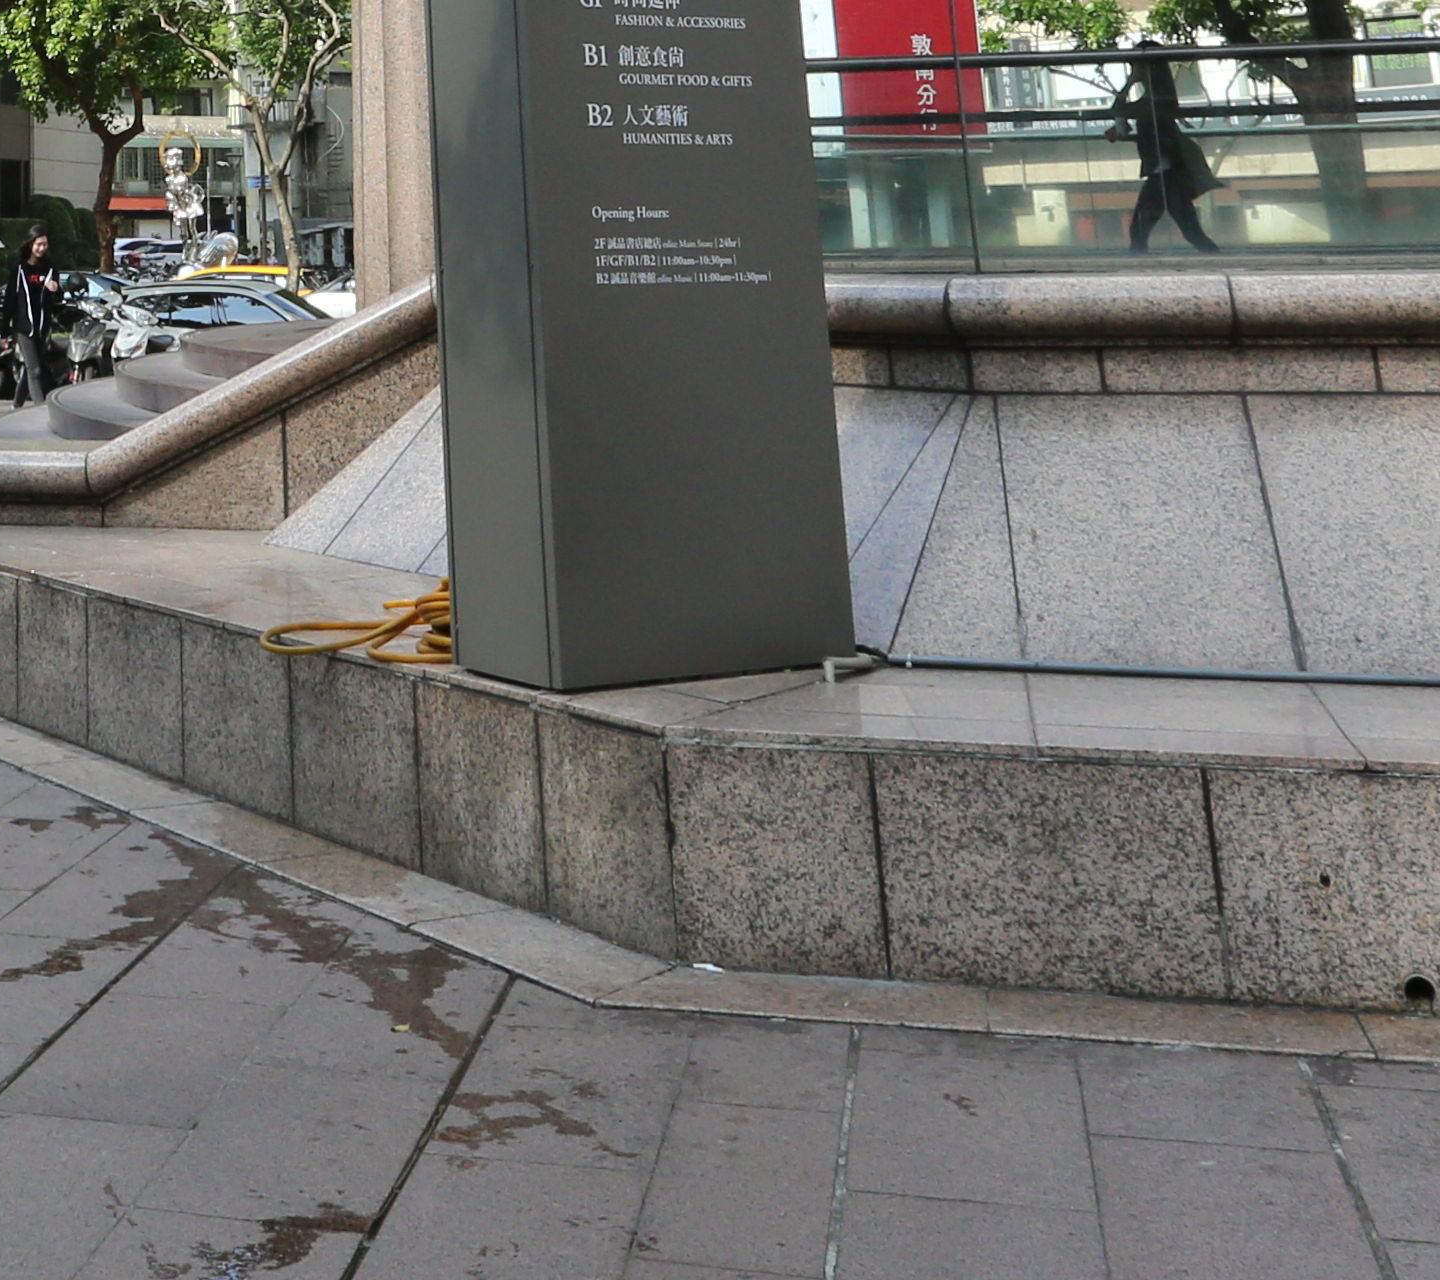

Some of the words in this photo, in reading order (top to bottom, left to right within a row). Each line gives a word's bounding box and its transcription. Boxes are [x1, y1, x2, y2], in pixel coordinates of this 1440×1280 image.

[615, 14, 664, 27] FASHION
[665, 16, 675, 27] &
[676, 16, 747, 30] ACCESSORIES
[582, 43, 609, 67] B1
[618, 44, 685, 69] 創意食尚
[618, 72, 676, 86] GOURMET
[677, 74, 709, 86] FOOD
[710, 75, 720, 86] &
[721, 75, 754, 88] GIFTS
[585, 103, 615, 127] B2
[622, 104, 689, 128] 人文藝術
[622, 132, 693, 146] HUMANITIES
[694, 134, 704, 146] &
[705, 134, 734, 146] ARTS
[591, 206, 636, 223] Opening
[636, 206, 670, 219] Hours:
[593, 237, 607, 250] 2F
[595, 254, 657, 267] 1F/GF/B1/B2
[596, 272, 610, 285] B2
